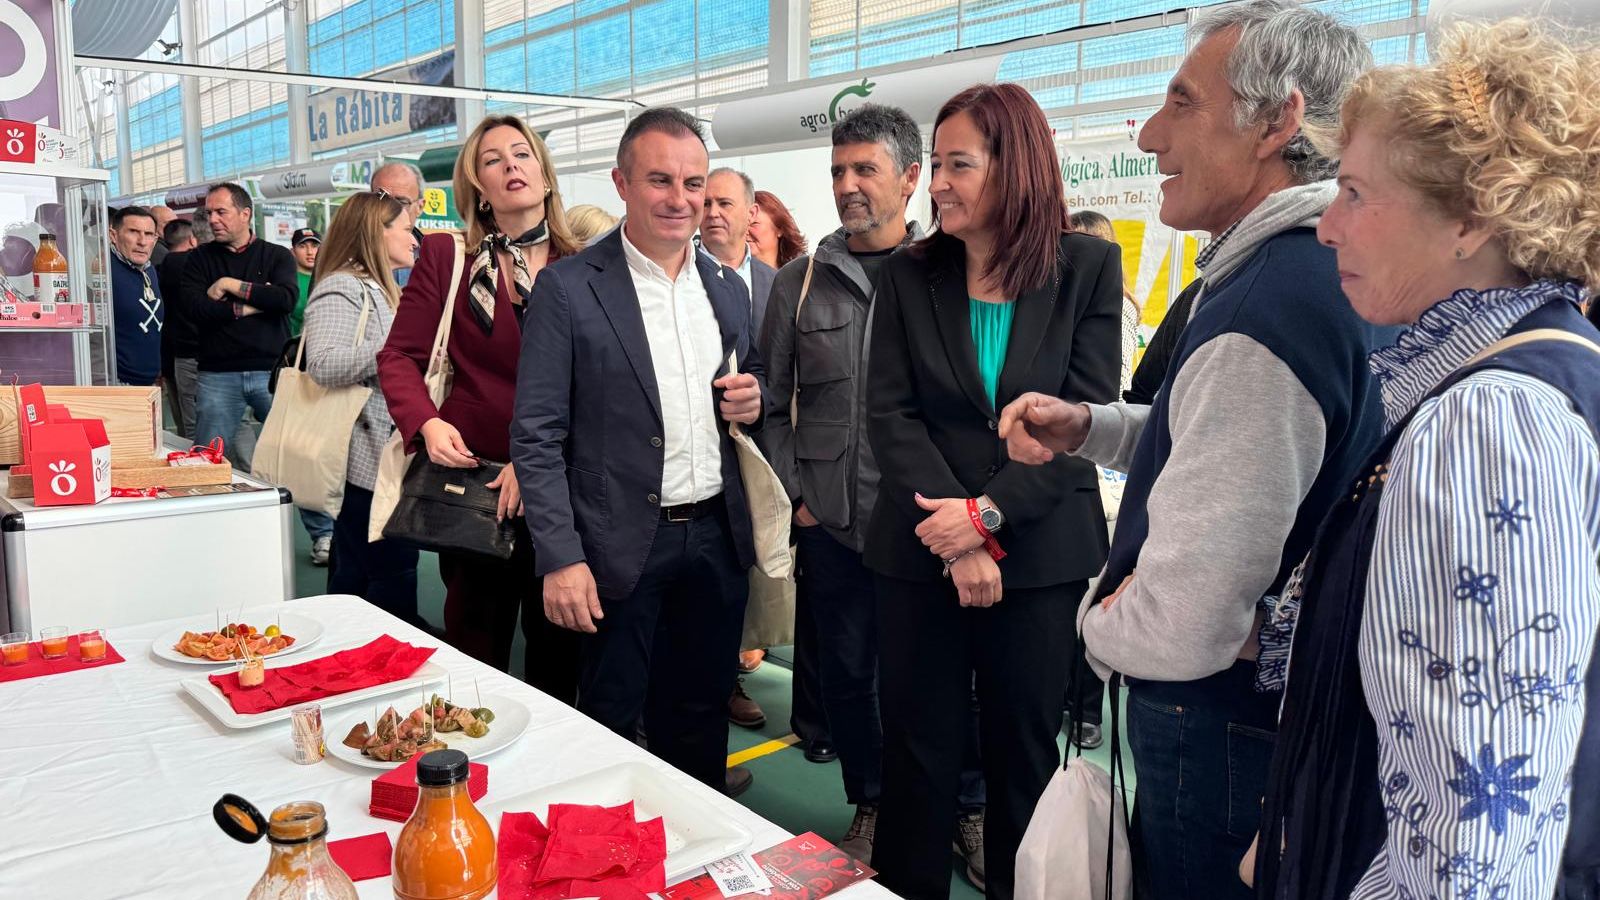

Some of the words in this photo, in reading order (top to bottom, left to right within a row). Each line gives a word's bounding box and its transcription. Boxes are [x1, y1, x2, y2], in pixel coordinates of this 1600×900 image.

[308, 105, 328, 142] La
[335, 90, 402, 135] Rábita
[800, 113, 827, 133] agro
